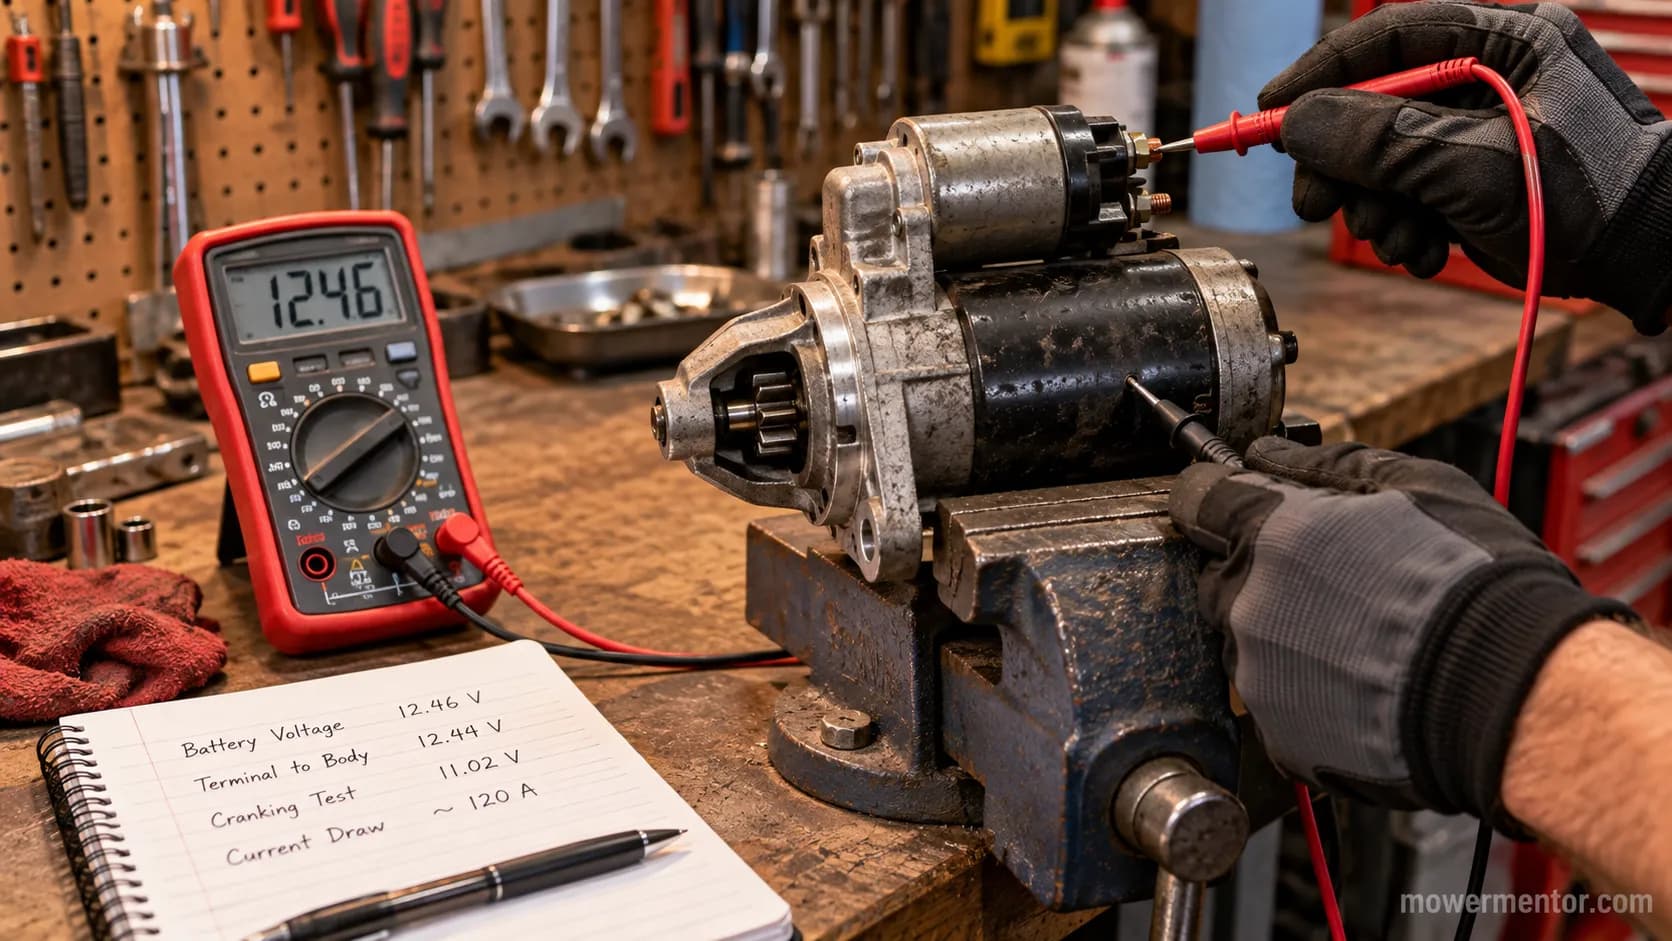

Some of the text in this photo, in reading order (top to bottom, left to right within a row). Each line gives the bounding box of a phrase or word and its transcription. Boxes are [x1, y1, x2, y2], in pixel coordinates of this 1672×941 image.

[270, 261, 384, 329] 12.46
[181, 689, 481, 758] Battery Voltage 12.46 V
[193, 718, 501, 793] Terminal to Body 12.44 V
[210, 749, 519, 829] Cranking Test 11.02 V
[226, 834, 312, 866] Current
[325, 821, 385, 844] Draw
[468, 789, 510, 811] 120
[521, 782, 538, 799] A
